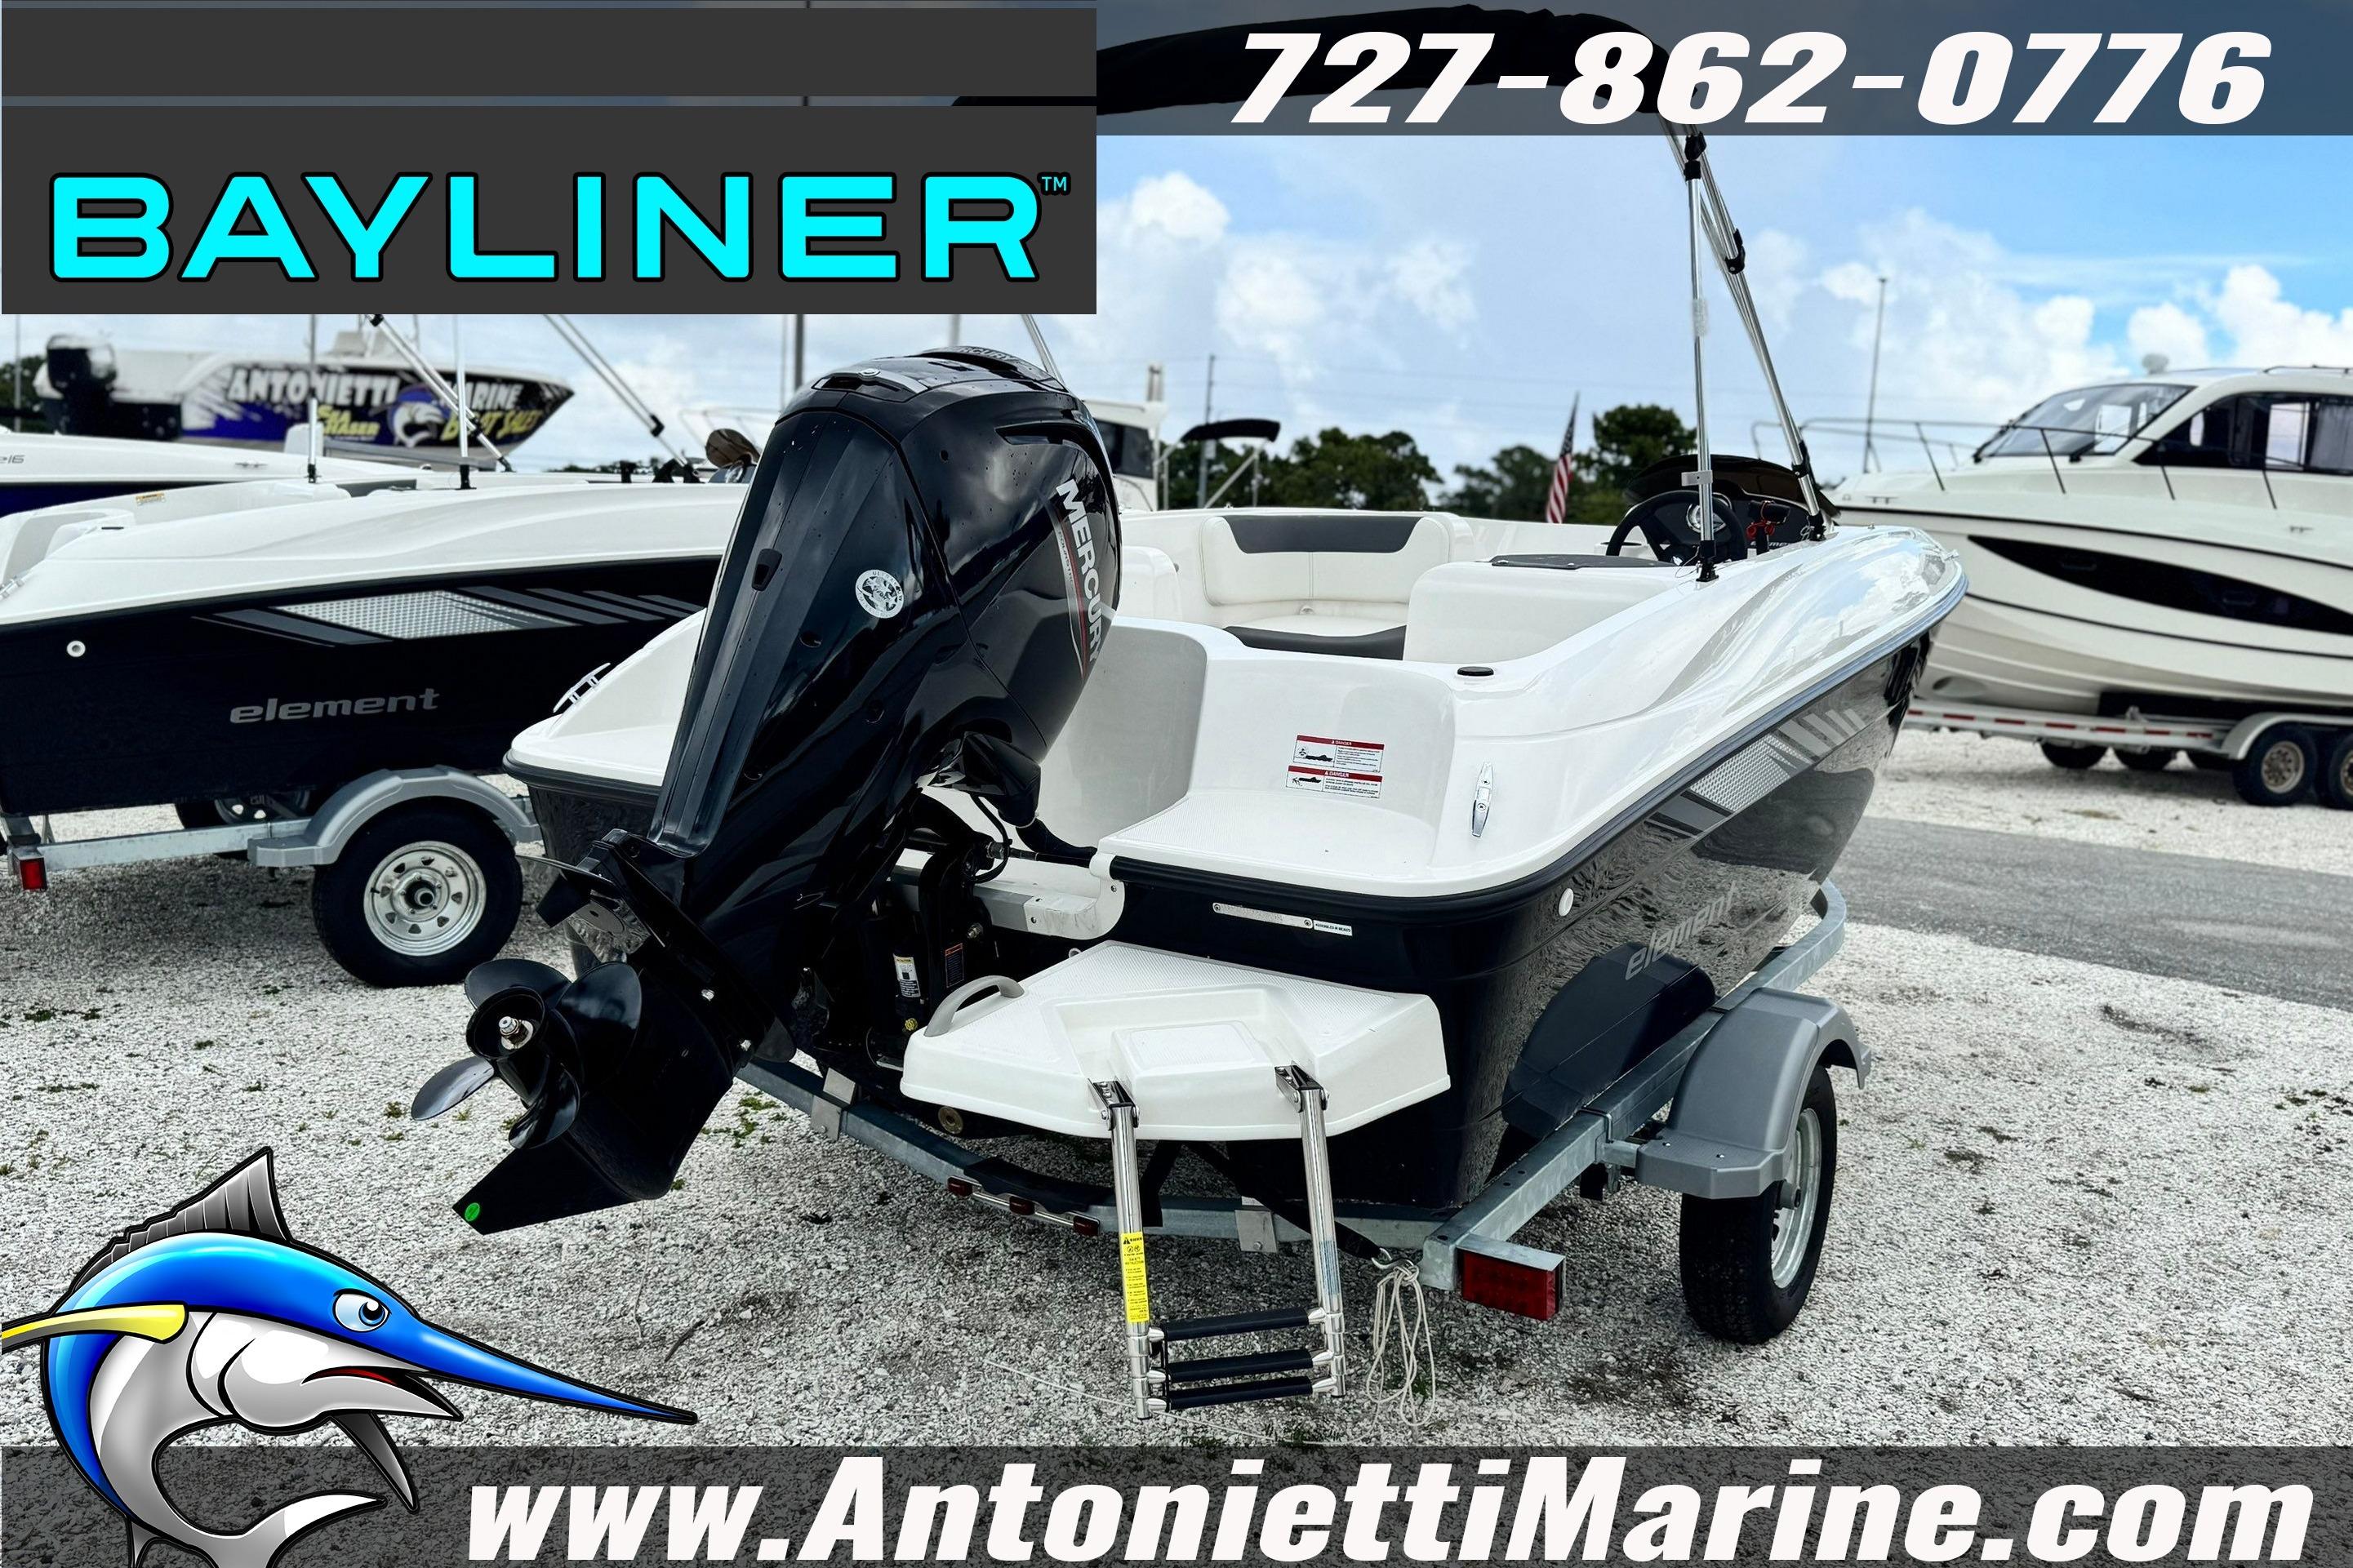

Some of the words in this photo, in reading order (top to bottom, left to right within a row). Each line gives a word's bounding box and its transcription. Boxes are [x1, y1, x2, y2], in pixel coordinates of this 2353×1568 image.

[227, 367, 399, 407] ANTONIETTI
[229, 687, 440, 724] element
[1625, 880, 1737, 980] element
